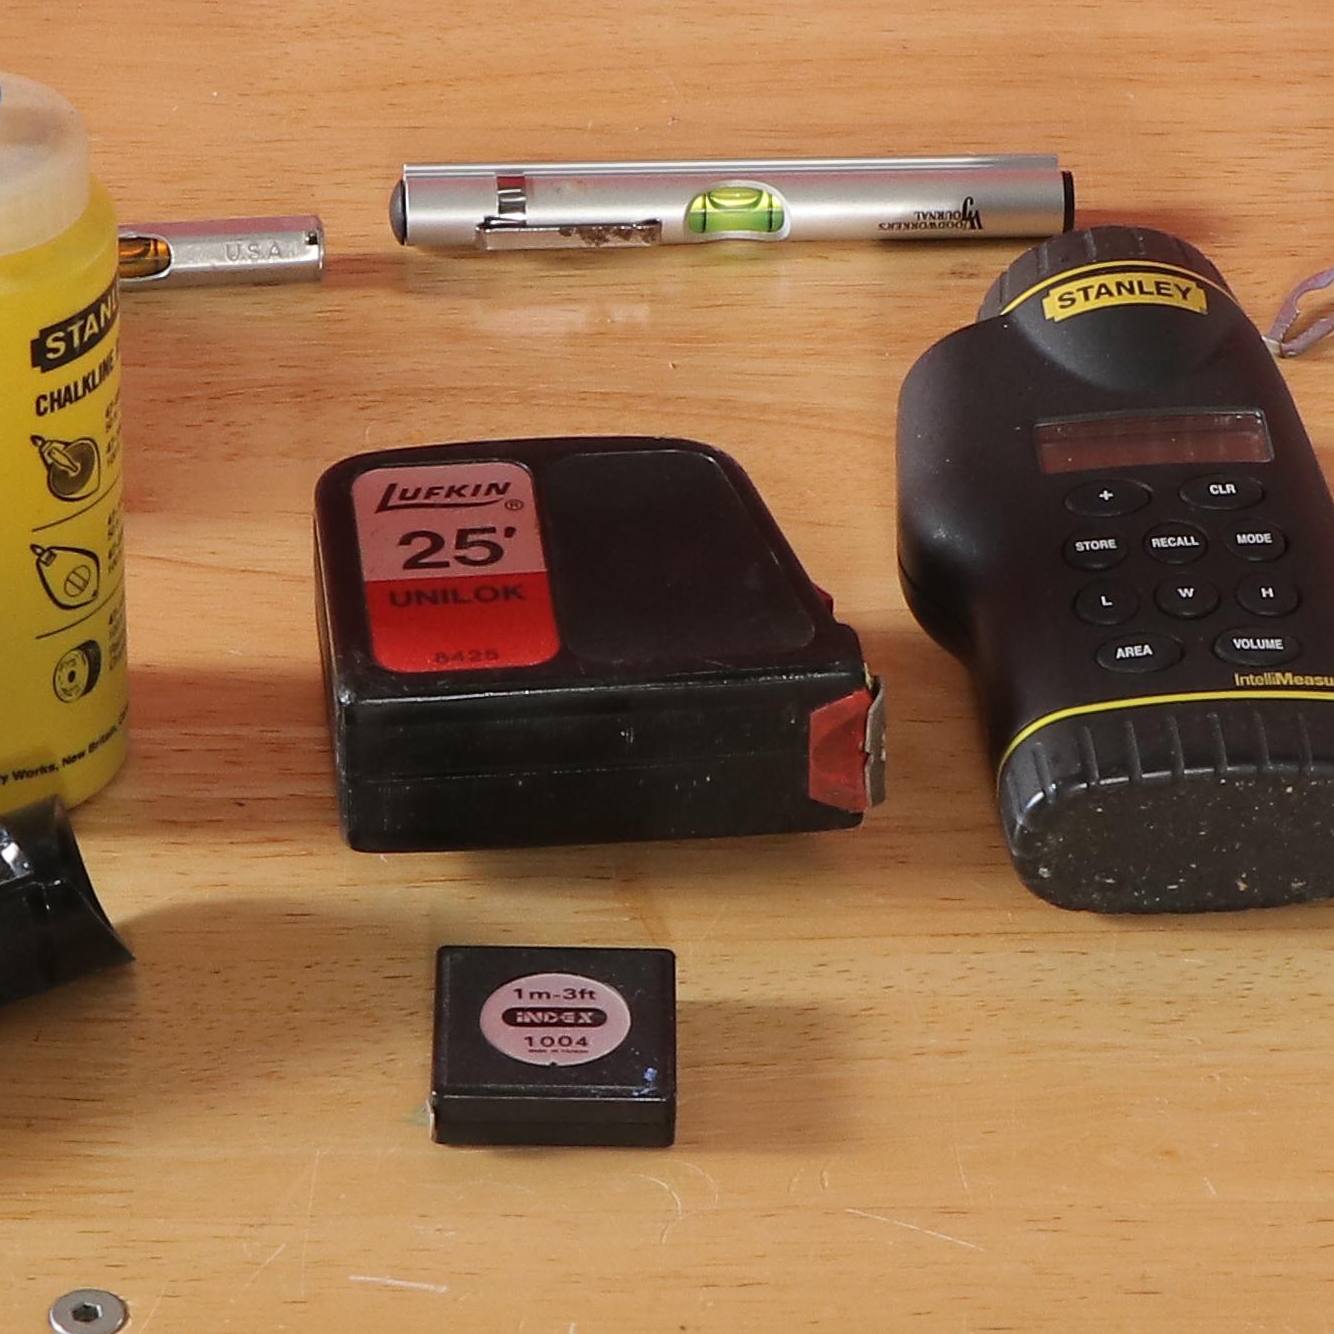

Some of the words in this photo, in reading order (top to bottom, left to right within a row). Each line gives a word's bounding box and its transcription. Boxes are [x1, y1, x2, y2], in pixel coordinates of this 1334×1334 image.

[1057, 279, 1192, 310] STANLEY
[1208, 483, 1237, 496] CLR
[375, 481, 512, 514] LUFKIN
[1075, 538, 1118, 552] STORE
[1150, 535, 1201, 549] RECALL
[1235, 532, 1274, 545] MODE
[397, 525, 517, 570] 25'
[388, 584, 526, 608] UNILOK
[1177, 587, 1195, 599] W
[1260, 586, 1275, 599] H
[1100, 595, 1114, 607] L
[1232, 638, 1285, 651] VOLUME
[1115, 644, 1154, 660] AREA
[61, 748, 87, 767] New
[523, 1035, 589, 1048] 1004
